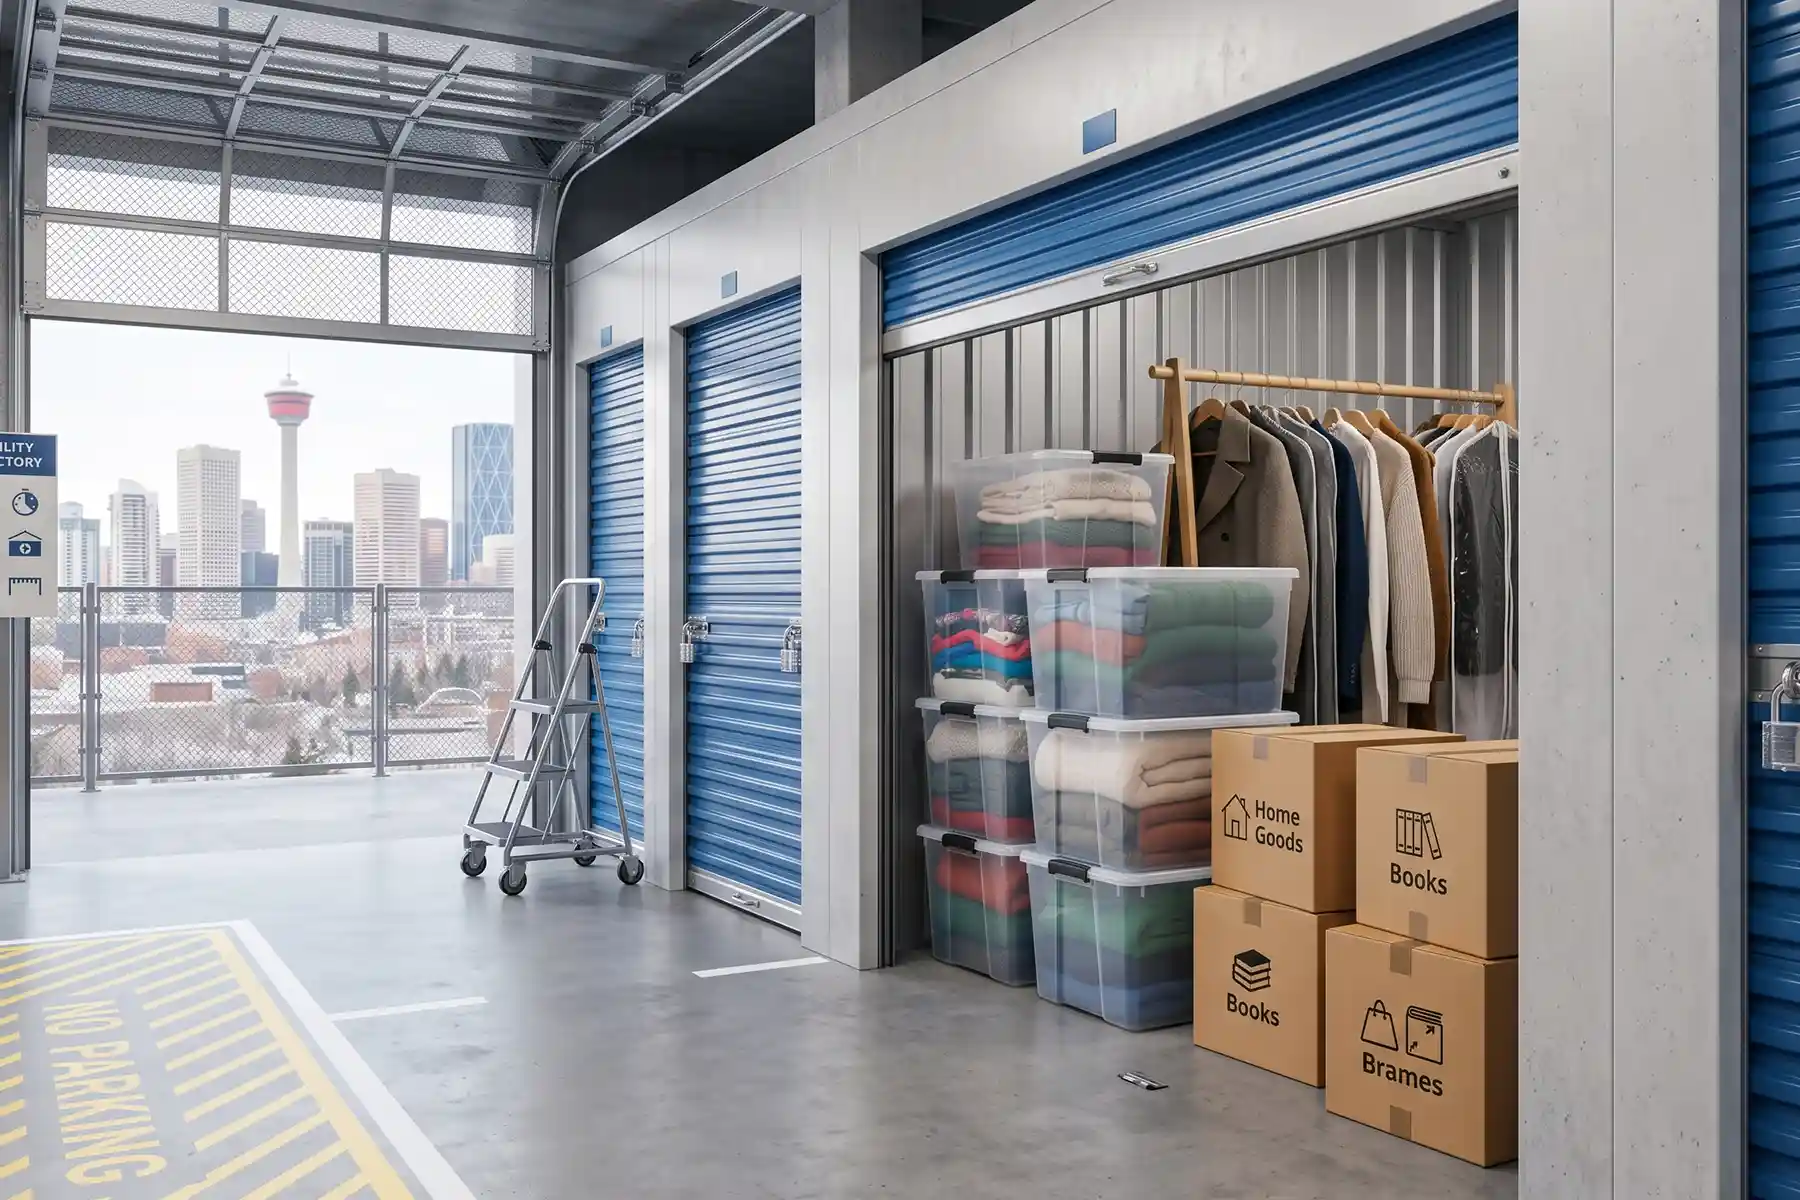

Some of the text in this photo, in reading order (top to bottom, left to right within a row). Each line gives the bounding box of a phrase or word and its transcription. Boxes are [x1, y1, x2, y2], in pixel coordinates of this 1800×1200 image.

[1255, 799, 1300, 826] Home
[1255, 825, 1304, 853] Goods
[1390, 862, 1448, 896] Books
[1226, 992, 1280, 1027] Books
[1362, 1051, 1444, 1097] Brames
[42, 1000, 168, 1187] NO PARKING
